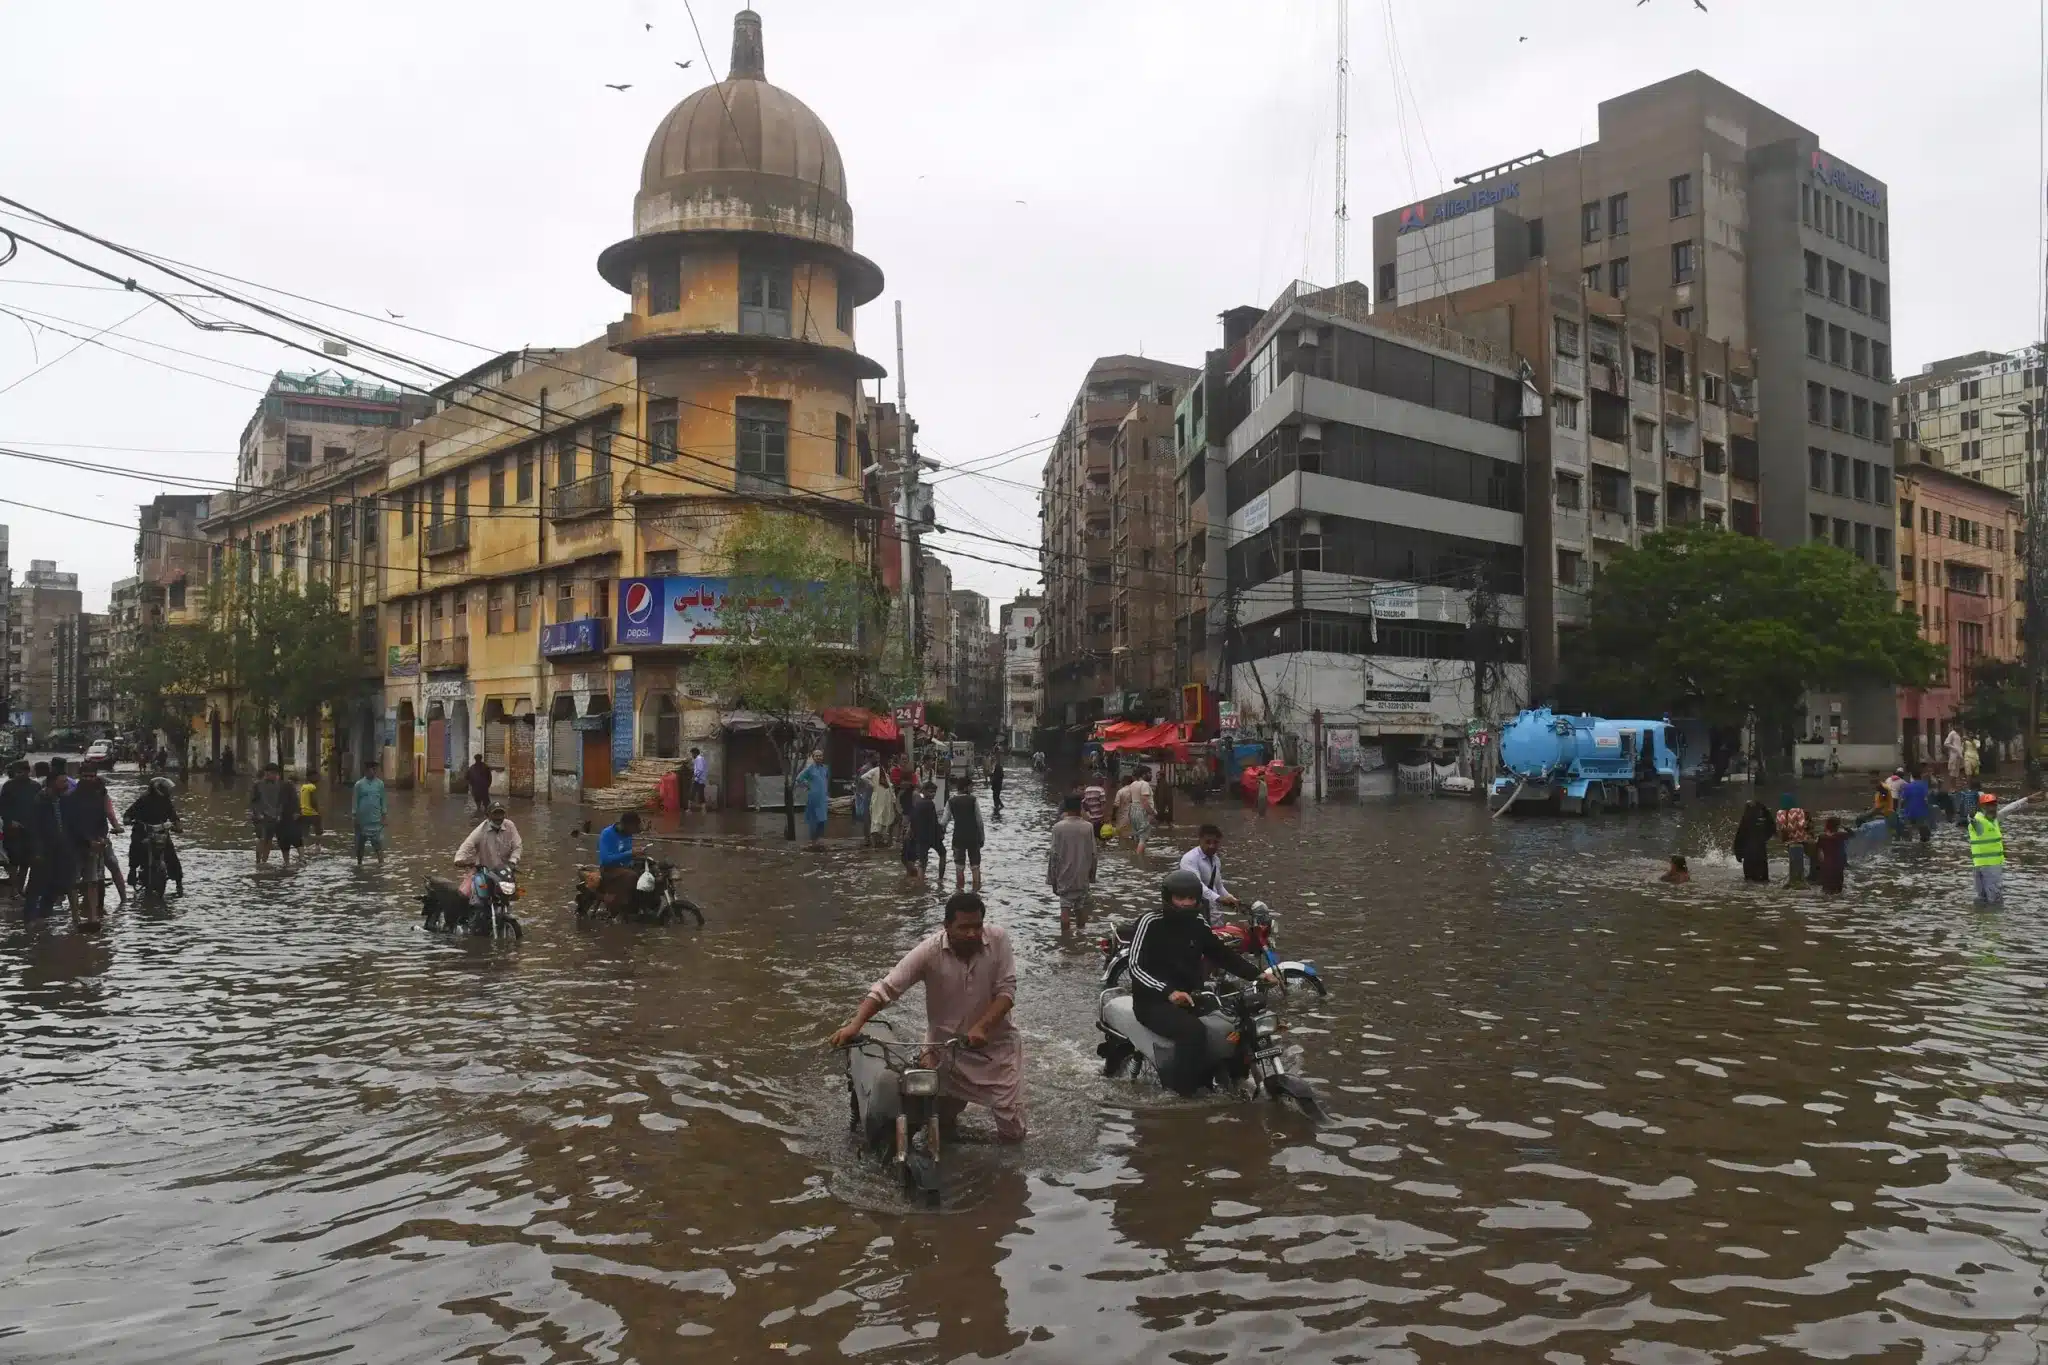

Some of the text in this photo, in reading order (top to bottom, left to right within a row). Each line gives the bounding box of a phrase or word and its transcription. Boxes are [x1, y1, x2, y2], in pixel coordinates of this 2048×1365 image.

[1435, 183, 1519, 217] Allied Bank
[626, 627, 648, 640] pepsi
